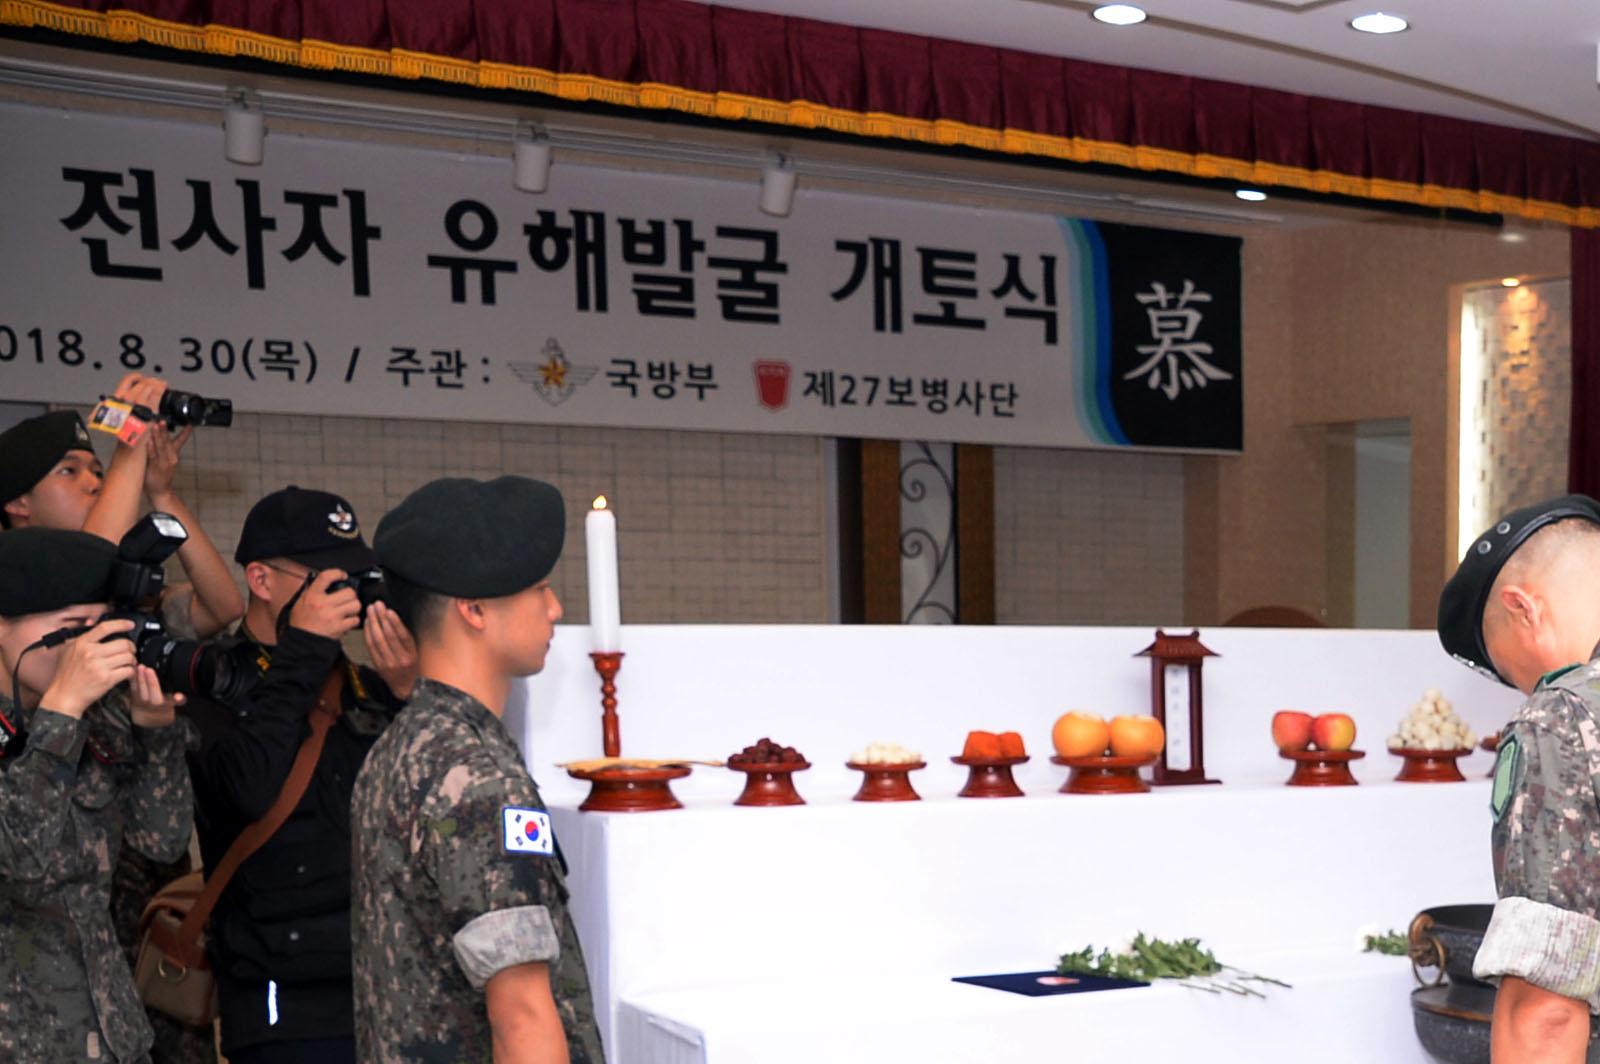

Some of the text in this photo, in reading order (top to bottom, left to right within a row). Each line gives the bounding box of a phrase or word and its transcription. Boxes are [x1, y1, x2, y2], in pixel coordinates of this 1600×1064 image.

[58, 159, 1059, 346] 전사자 유해발굴 개토식
[0, 324, 319, 375] 018.8.30(목)
[605, 358, 719, 401] 국방부
[802, 371, 1020, 418] 제27보병사단
[1122, 279, 1234, 400] 慕
